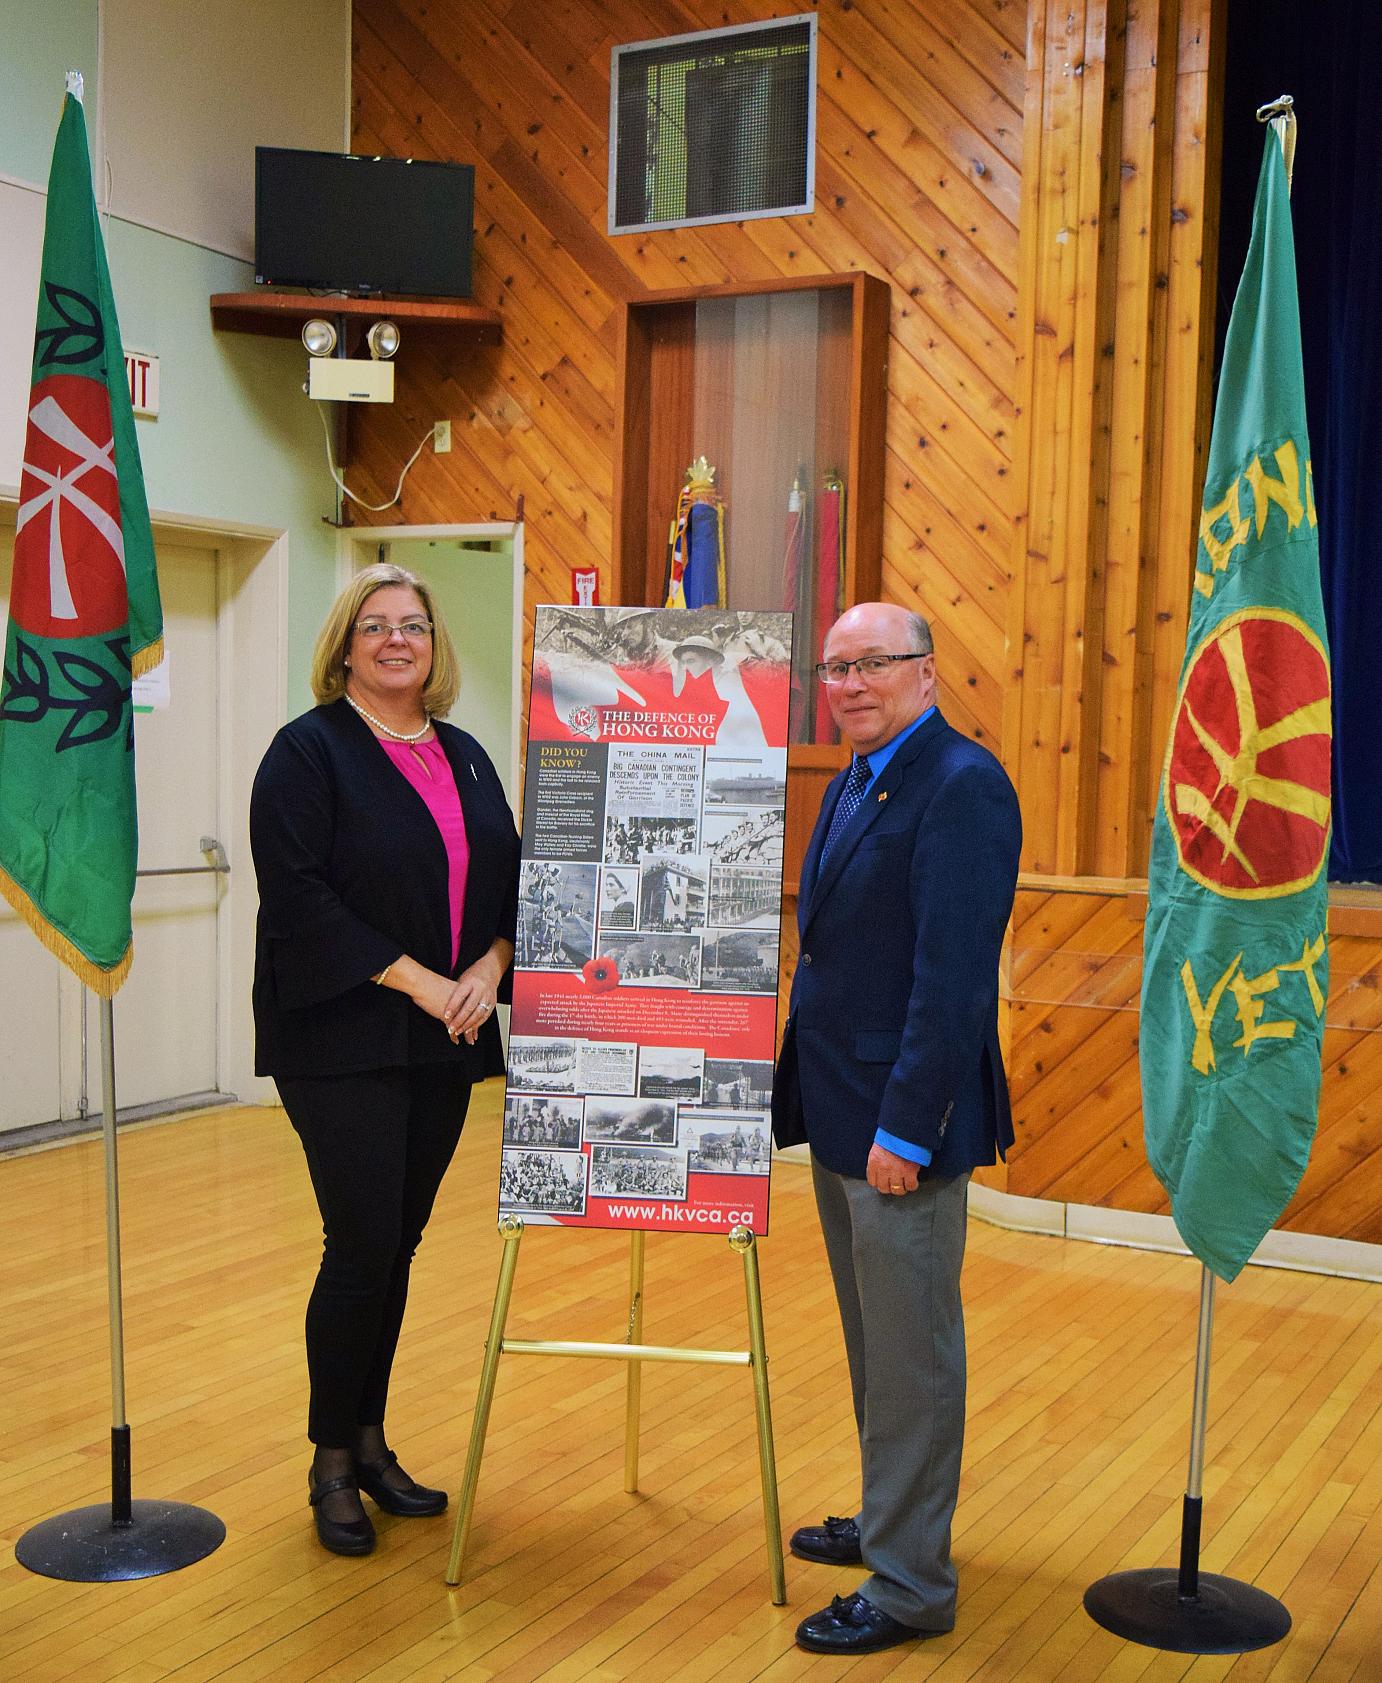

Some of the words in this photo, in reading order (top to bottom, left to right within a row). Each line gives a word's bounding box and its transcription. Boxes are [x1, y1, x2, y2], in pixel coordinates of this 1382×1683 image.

[124, 357, 150, 408] IT
[577, 577, 595, 585] FIRE
[603, 711, 630, 721] THE
[633, 712, 696, 723] DEFENCE
[698, 714, 716, 724] OF
[603, 722, 658, 737] HONG
[663, 725, 716, 739] KONG
[541, 748, 562, 756] DID
[565, 748, 588, 757] YOU
[617, 750, 634, 758] THE
[640, 751, 667, 759] CHINA
[674, 752, 696, 760] MAIL
[540, 758, 582, 768] KNOW?
[613, 763, 623, 771] BIG
[628, 764, 657, 772] CANADIAN
[661, 765, 697, 773] CONTINGENT
[609, 771, 639, 779] DESCENDS
[663, 773, 673, 781] THE
[608, 1203, 754, 1225] www.hkvca.ca
